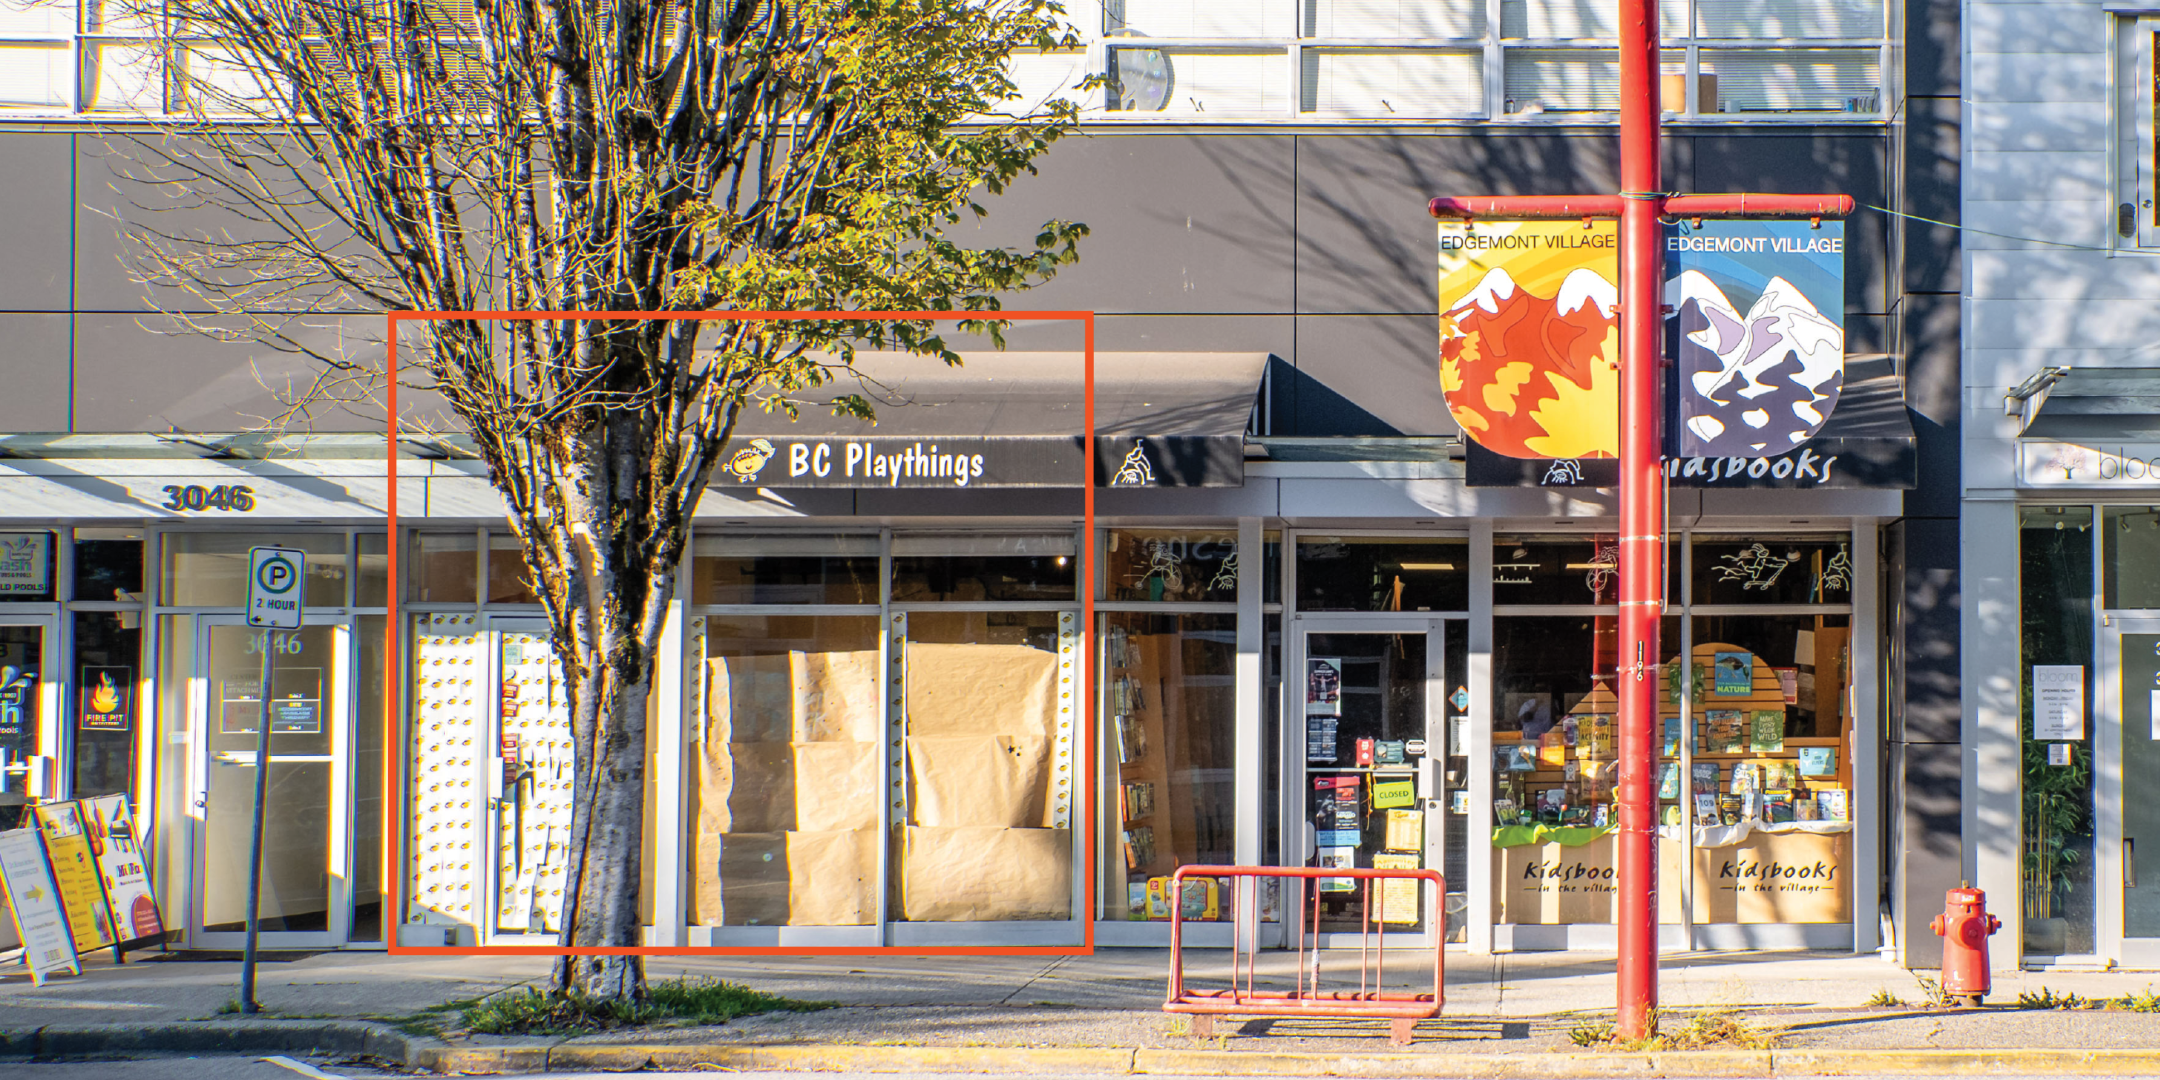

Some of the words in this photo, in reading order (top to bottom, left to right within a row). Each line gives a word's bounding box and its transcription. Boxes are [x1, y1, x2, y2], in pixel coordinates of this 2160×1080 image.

[1441, 234, 1540, 250] EDGEMONT
[1545, 234, 1615, 249] VILLAGE
[1667, 236, 1768, 252] EDGEMONT
[1771, 237, 1843, 253] VILLAGE
[789, 442, 832, 477] BC
[845, 442, 984, 487] Playthings
[1660, 448, 1838, 483] idsbooks
[162, 484, 257, 511] 3046
[269, 565, 288, 586] P
[14, 583, 45, 591] POOLS
[256, 598, 265, 608] 2
[267, 599, 296, 611] HOUR
[2038, 669, 2079, 683] bloom
[1717, 685, 1750, 693] NATURE
[85, 713, 107, 722] FIRE
[108, 713, 124, 722] PIT
[1757, 732, 1778, 741] WILD
[1379, 790, 1410, 799] CLOSED
[1523, 860, 1619, 882] Kidsboo
[1719, 860, 1838, 881] Kidsbooks
[1538, 883, 1550, 893] in
[1558, 883, 1577, 893] the
[1584, 883, 1618, 894] villag
[1734, 882, 1746, 892] in
[1753, 883, 1773, 892] the
[1780, 882, 1820, 894] village
